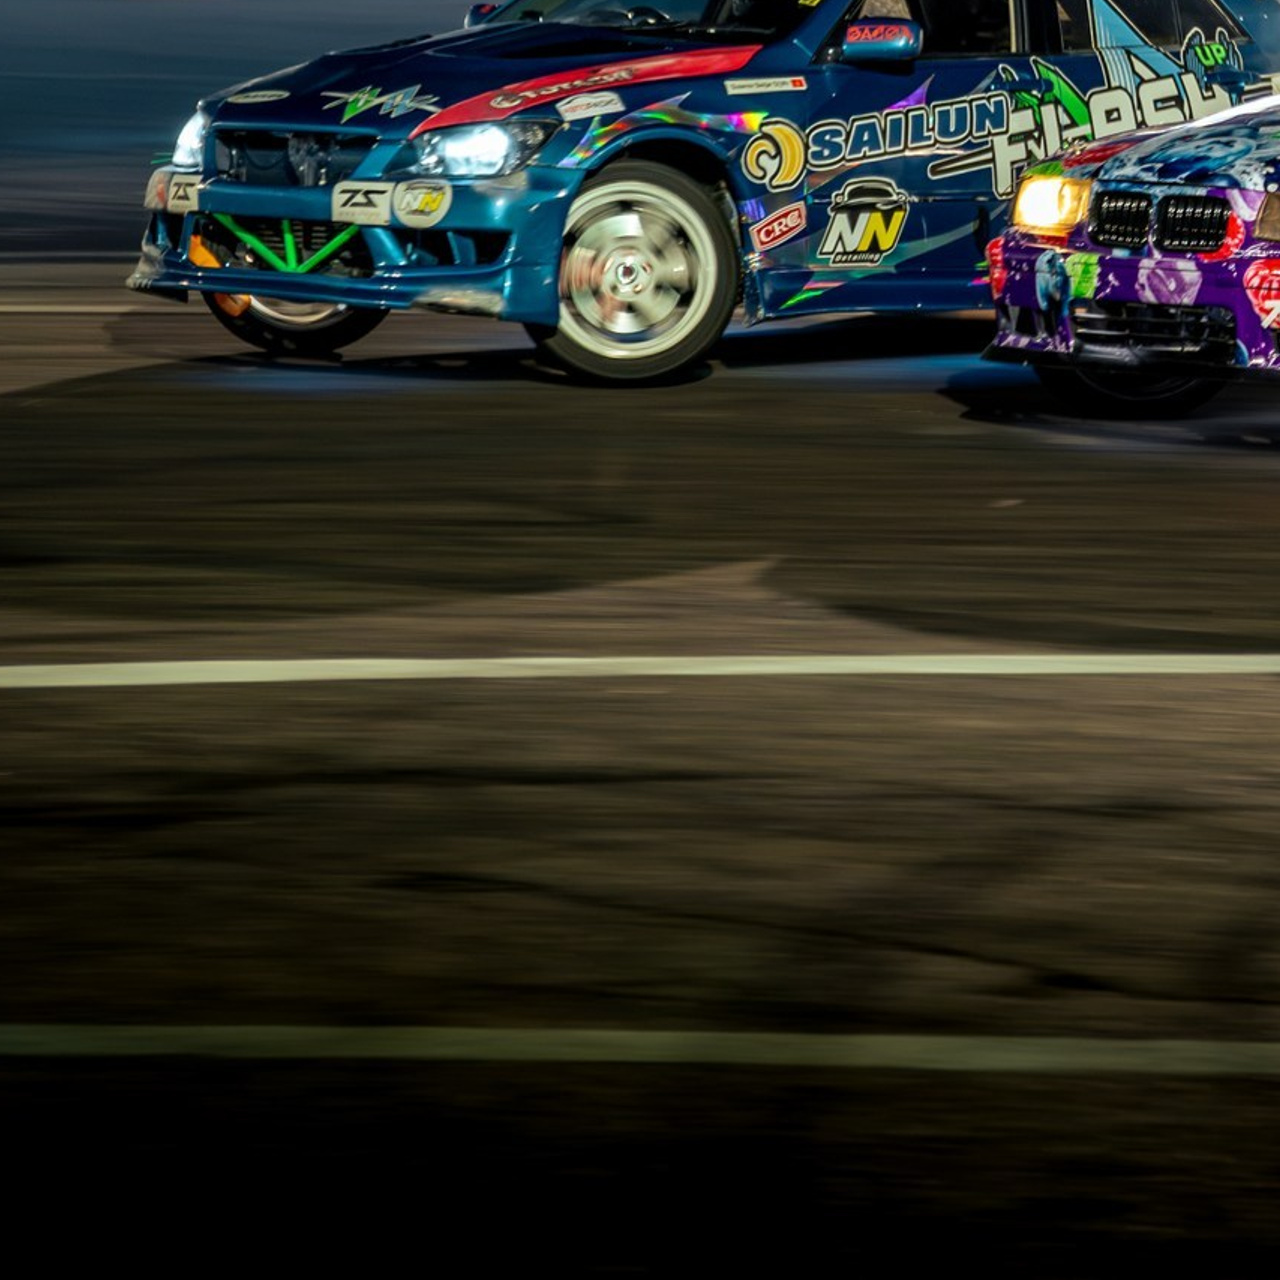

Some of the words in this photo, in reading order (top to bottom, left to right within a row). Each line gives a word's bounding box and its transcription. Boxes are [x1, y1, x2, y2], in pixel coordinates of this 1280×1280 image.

[1194, 42, 1228, 67] UP
[807, 92, 1009, 168] SAILUN
[759, 210, 801, 243] CRC
[821, 210, 906, 253] NN
